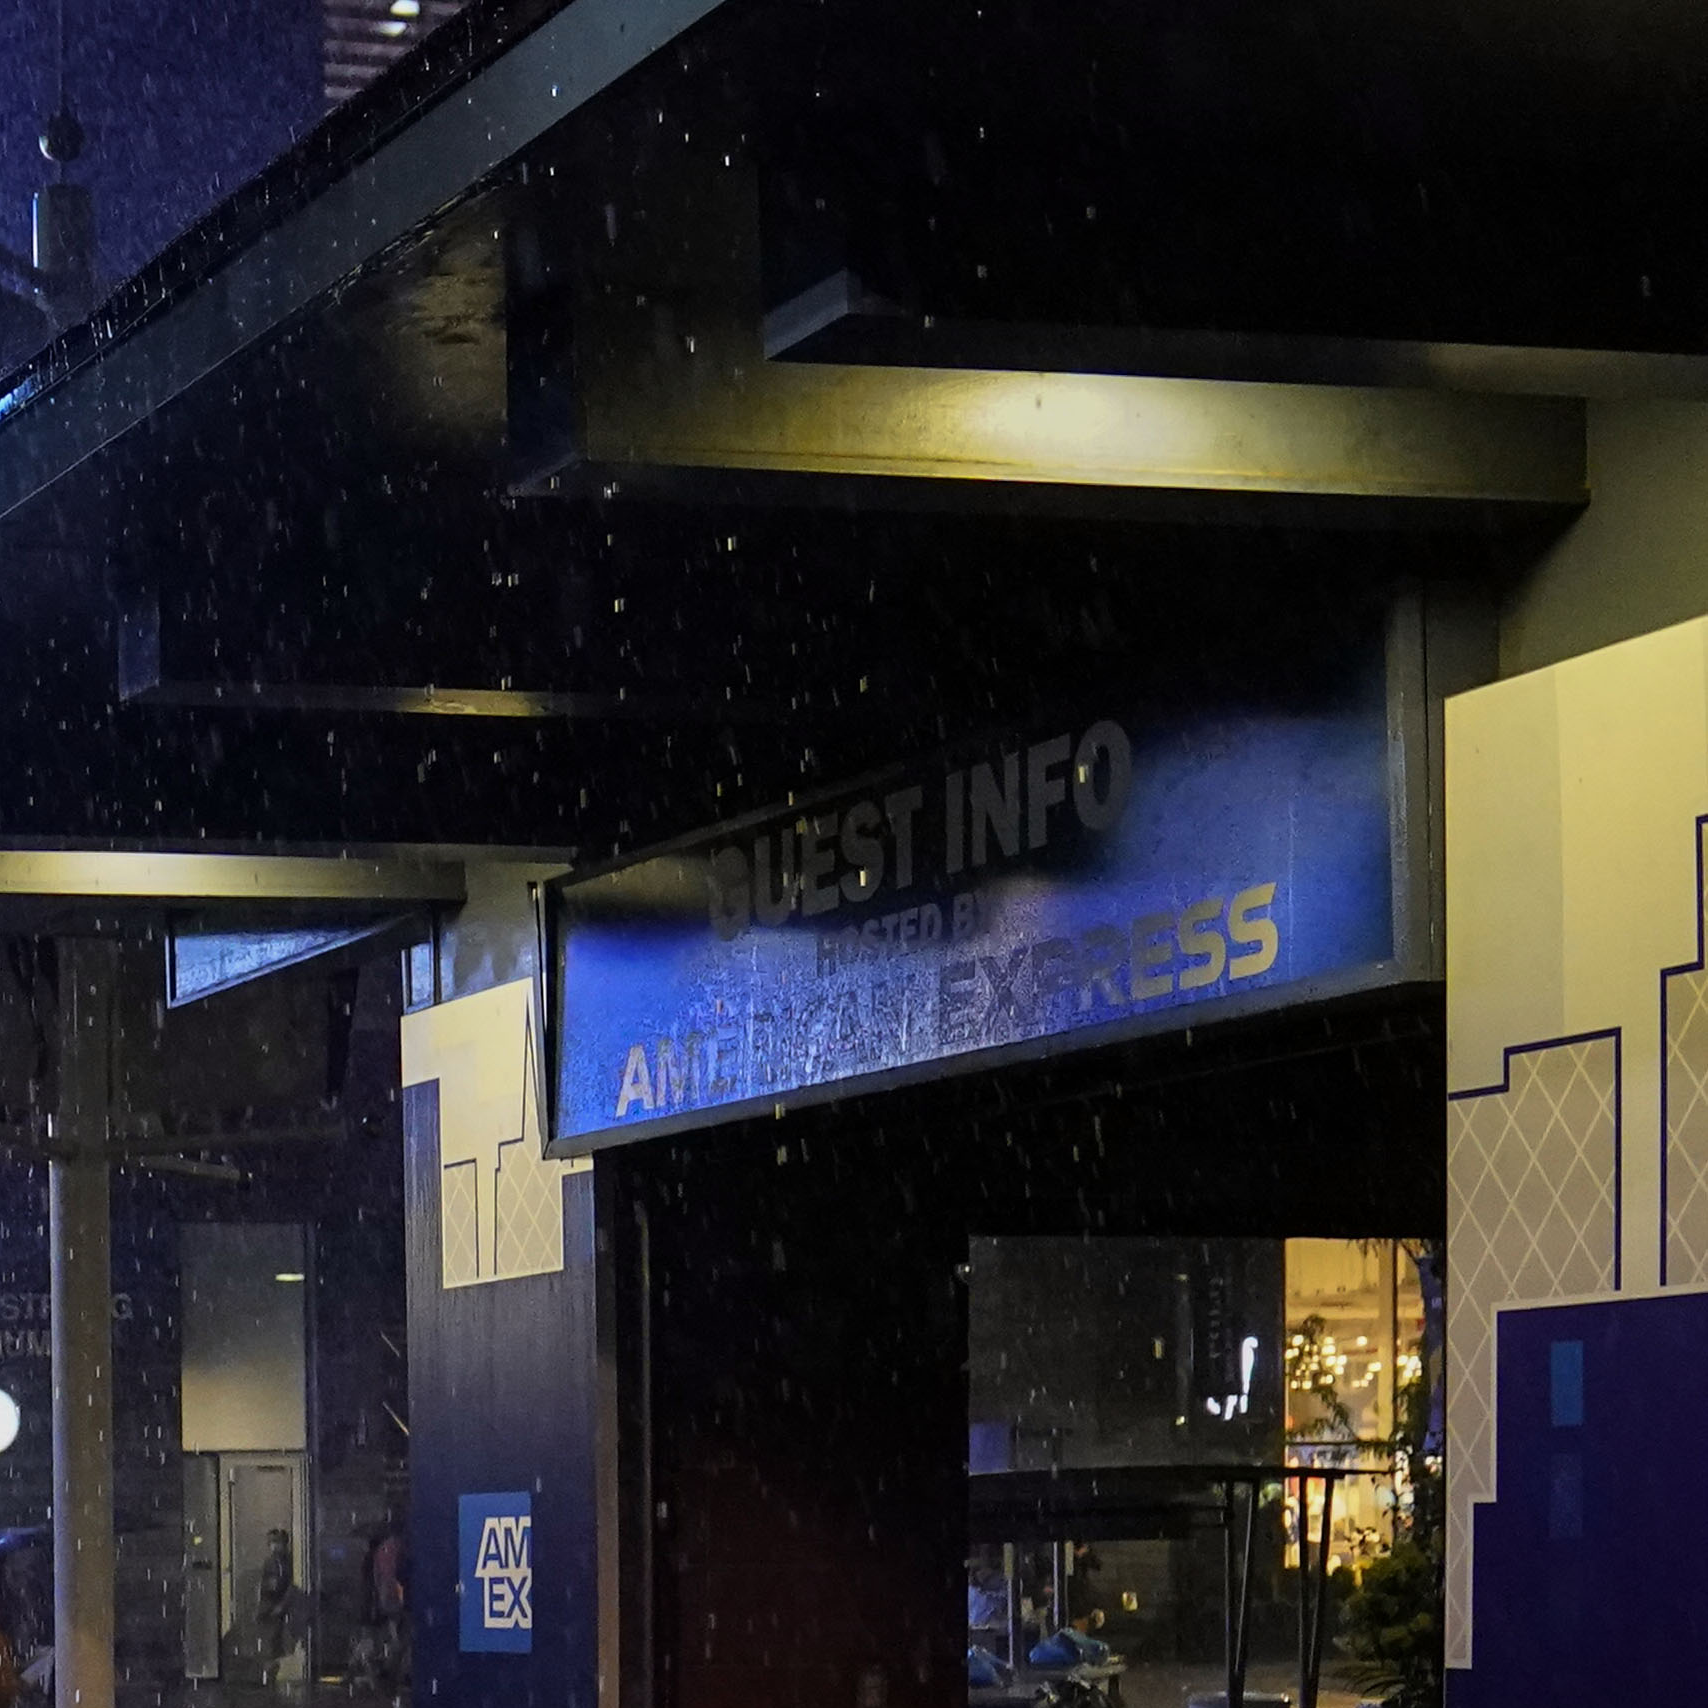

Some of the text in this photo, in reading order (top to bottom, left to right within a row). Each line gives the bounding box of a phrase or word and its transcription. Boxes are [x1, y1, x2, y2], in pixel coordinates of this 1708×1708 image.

[944, 720, 1132, 873] INFO
[937, 881, 1279, 1043] EXPRESS
[475, 1516, 532, 1578] AM
[484, 1574, 533, 1629] EX
